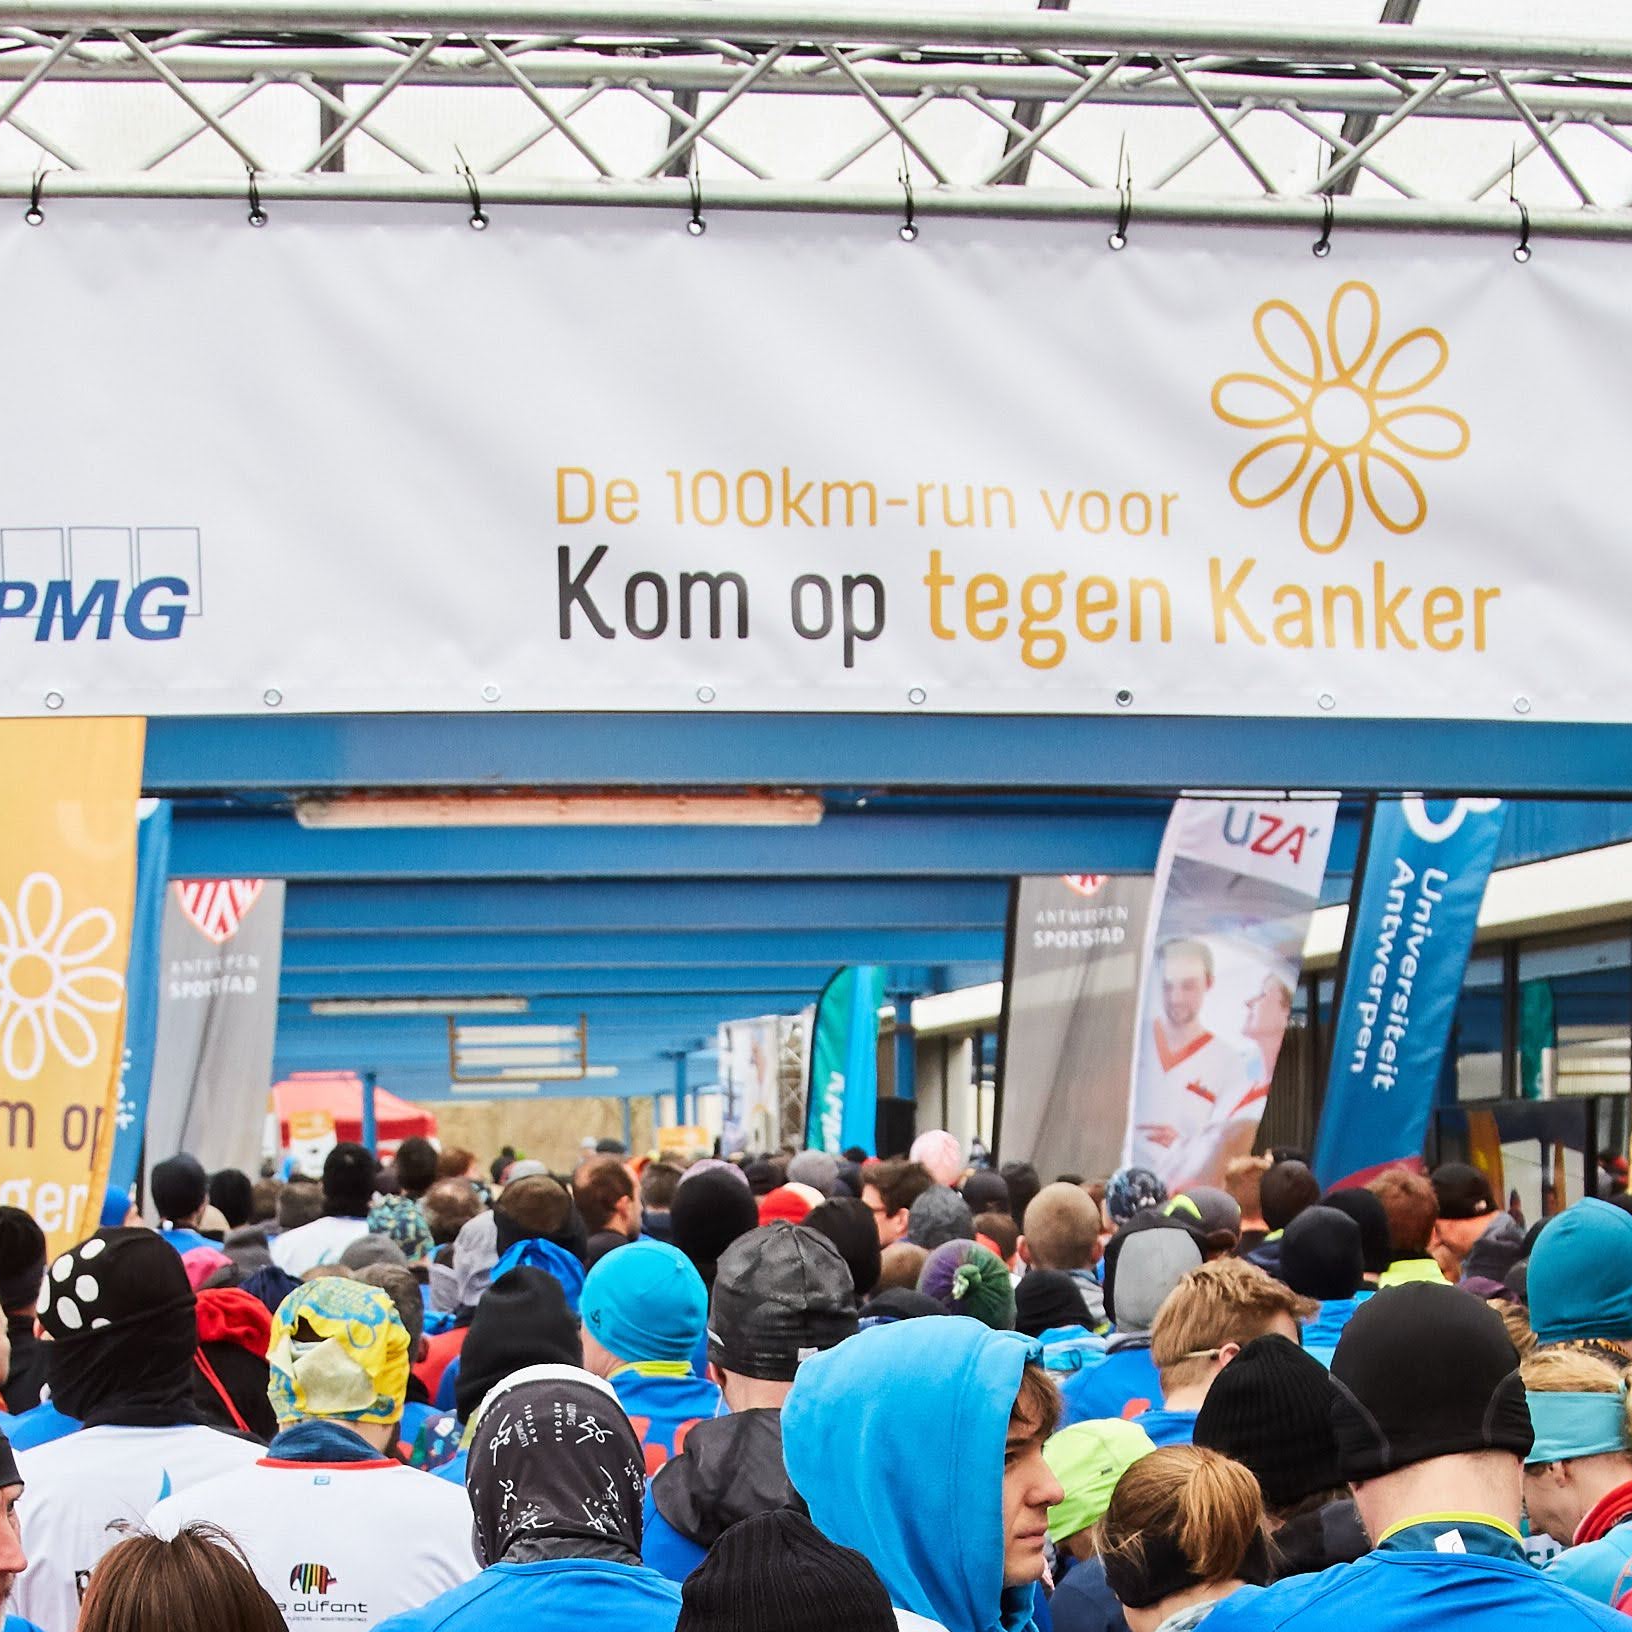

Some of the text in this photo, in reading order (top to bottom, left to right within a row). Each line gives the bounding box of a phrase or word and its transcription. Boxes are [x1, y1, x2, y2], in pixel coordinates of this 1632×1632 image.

[555, 465, 1180, 537] De 100km-run voor
[557, 544, 1502, 670] Kom op tegen Kanker
[1351, 857, 1417, 1075] Antwerpen
[1372, 866, 1449, 1092] Universiteit
[293, 1600, 369, 1613] olifant
